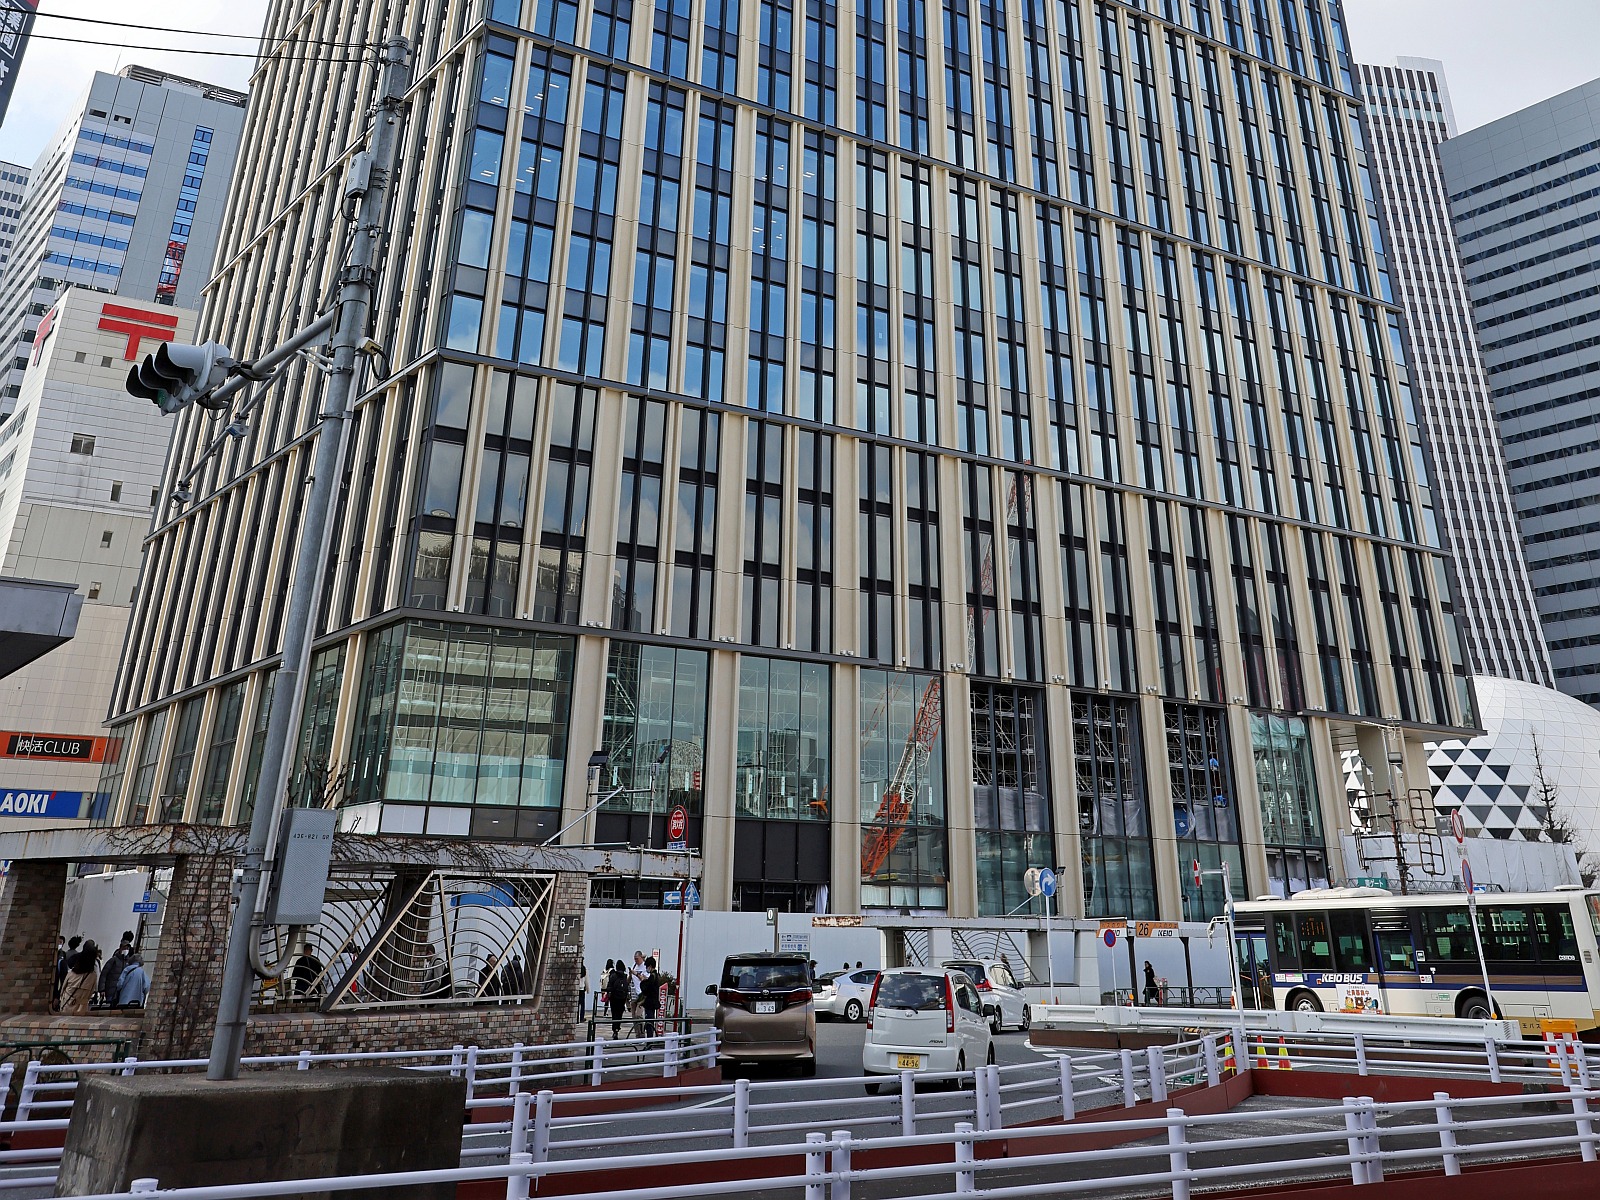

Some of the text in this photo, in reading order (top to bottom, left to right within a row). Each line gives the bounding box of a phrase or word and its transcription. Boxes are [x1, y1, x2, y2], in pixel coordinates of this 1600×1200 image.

[18, 739, 80, 755] 快活CLUB
[0, 792, 49, 814] AOKI
[560, 917, 566, 929] 6
[1138, 923, 1149, 936] 26
[1157, 929, 1173, 937] KEIO
[1321, 973, 1363, 983] KEIO BUS
